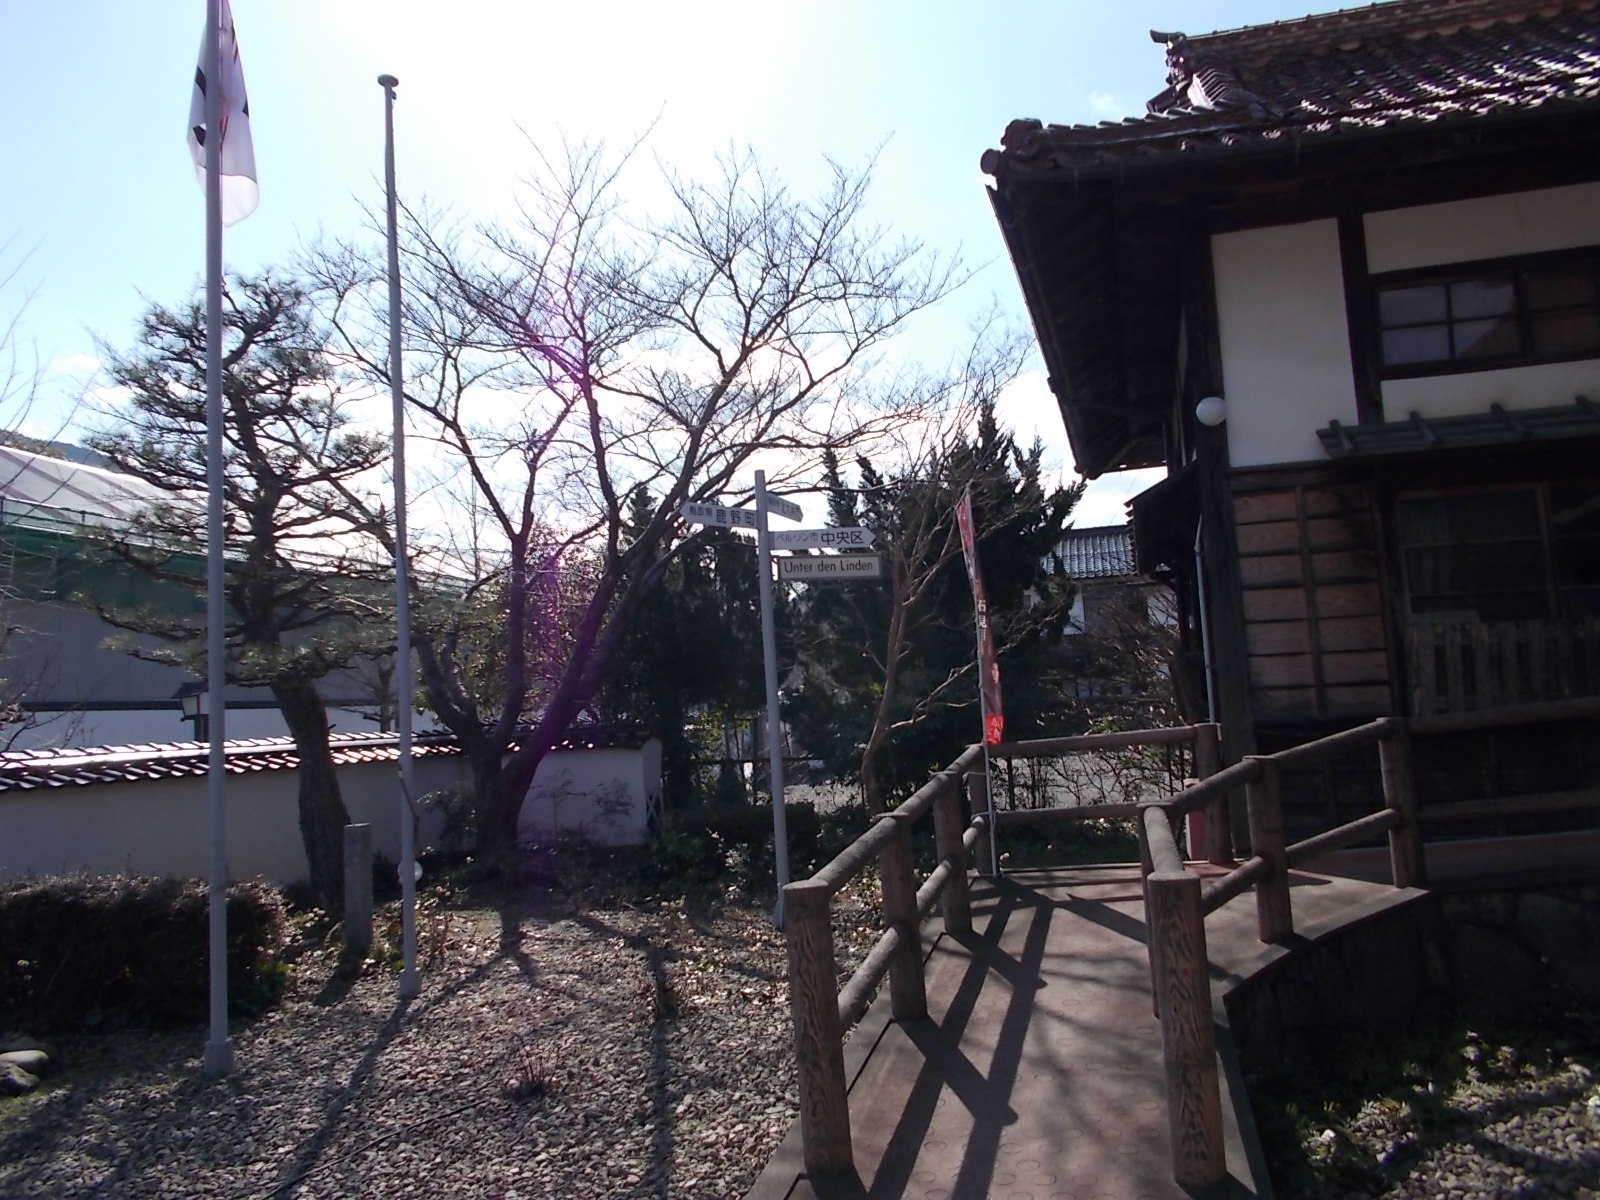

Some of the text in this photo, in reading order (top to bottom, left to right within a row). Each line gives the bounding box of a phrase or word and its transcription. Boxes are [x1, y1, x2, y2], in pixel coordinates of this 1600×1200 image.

[716, 508, 755, 526] 鹿野町
[821, 530, 864, 546] 中央区
[784, 560, 873, 573] Unter den Linden
